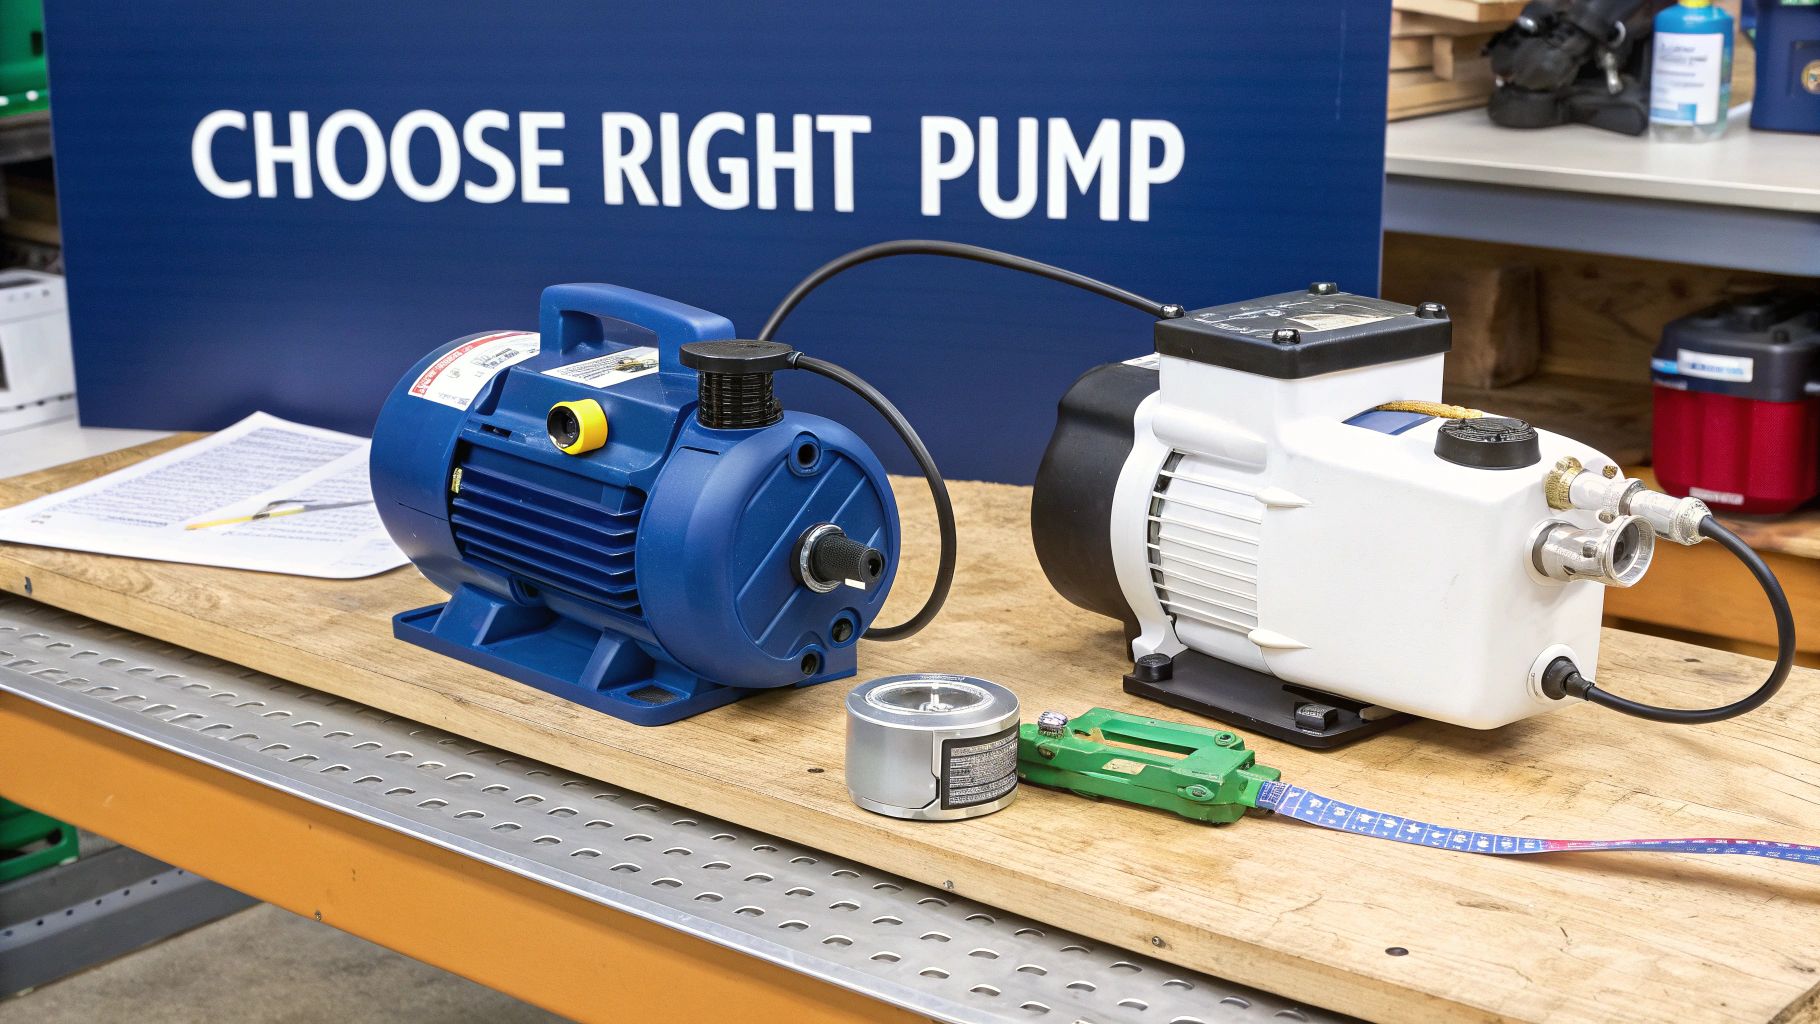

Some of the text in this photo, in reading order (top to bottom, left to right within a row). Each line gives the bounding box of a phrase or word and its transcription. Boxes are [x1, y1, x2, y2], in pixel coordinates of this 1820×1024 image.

[191, 109, 1185, 222] CHOOSE RIGHT PUMP
